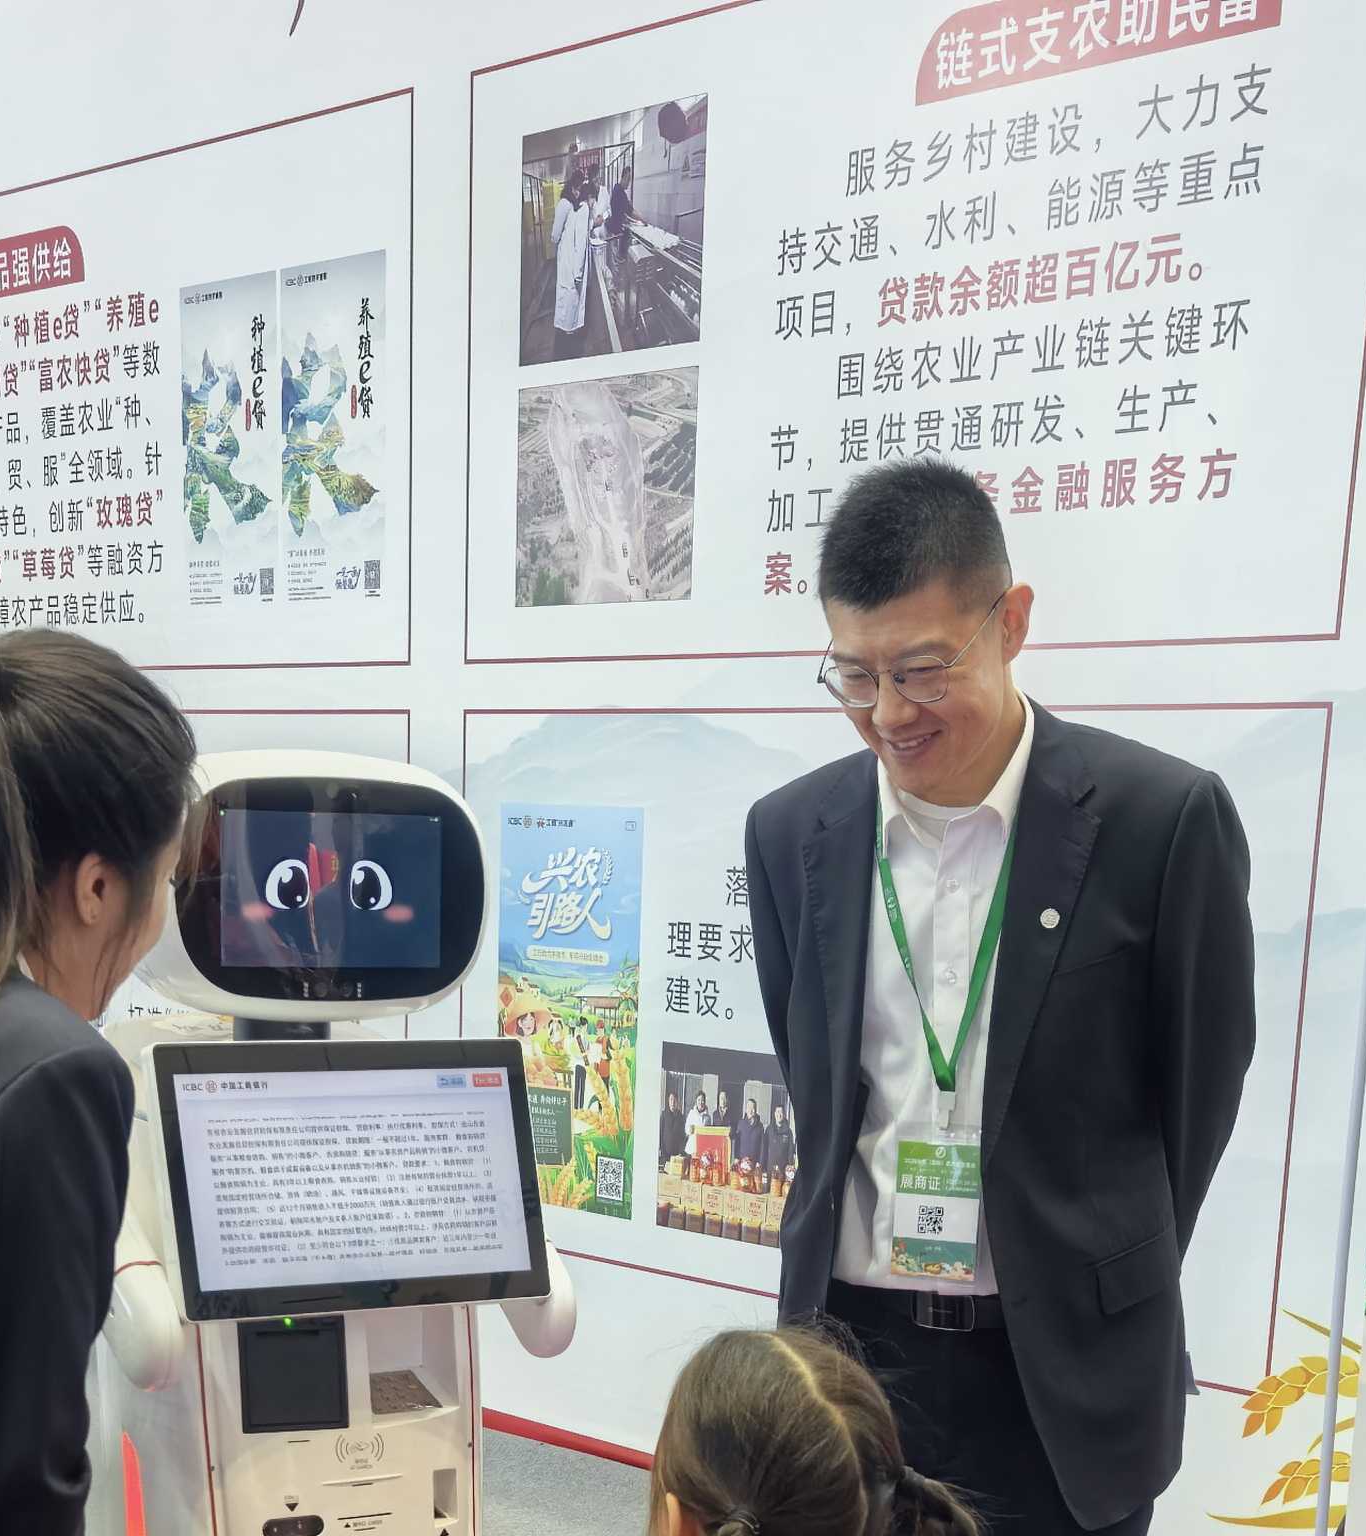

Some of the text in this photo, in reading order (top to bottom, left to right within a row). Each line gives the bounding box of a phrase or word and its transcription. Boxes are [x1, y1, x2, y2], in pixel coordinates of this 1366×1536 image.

[846, 63, 1272, 198] 服务乡村建设，大力支
[776, 143, 1264, 276] 持交通、水利、能源等重点
[774, 232, 1203, 339] 项目，贷款余额超百亿元。
[835, 299, 1251, 400] 围绕农业产业链关键环
[770, 379, 1219, 472] 节，提供贯通研发、生产、
[763, 552, 808, 596] 案。
[667, 919, 754, 964] 理要求
[664, 975, 734, 1022] 建设。
